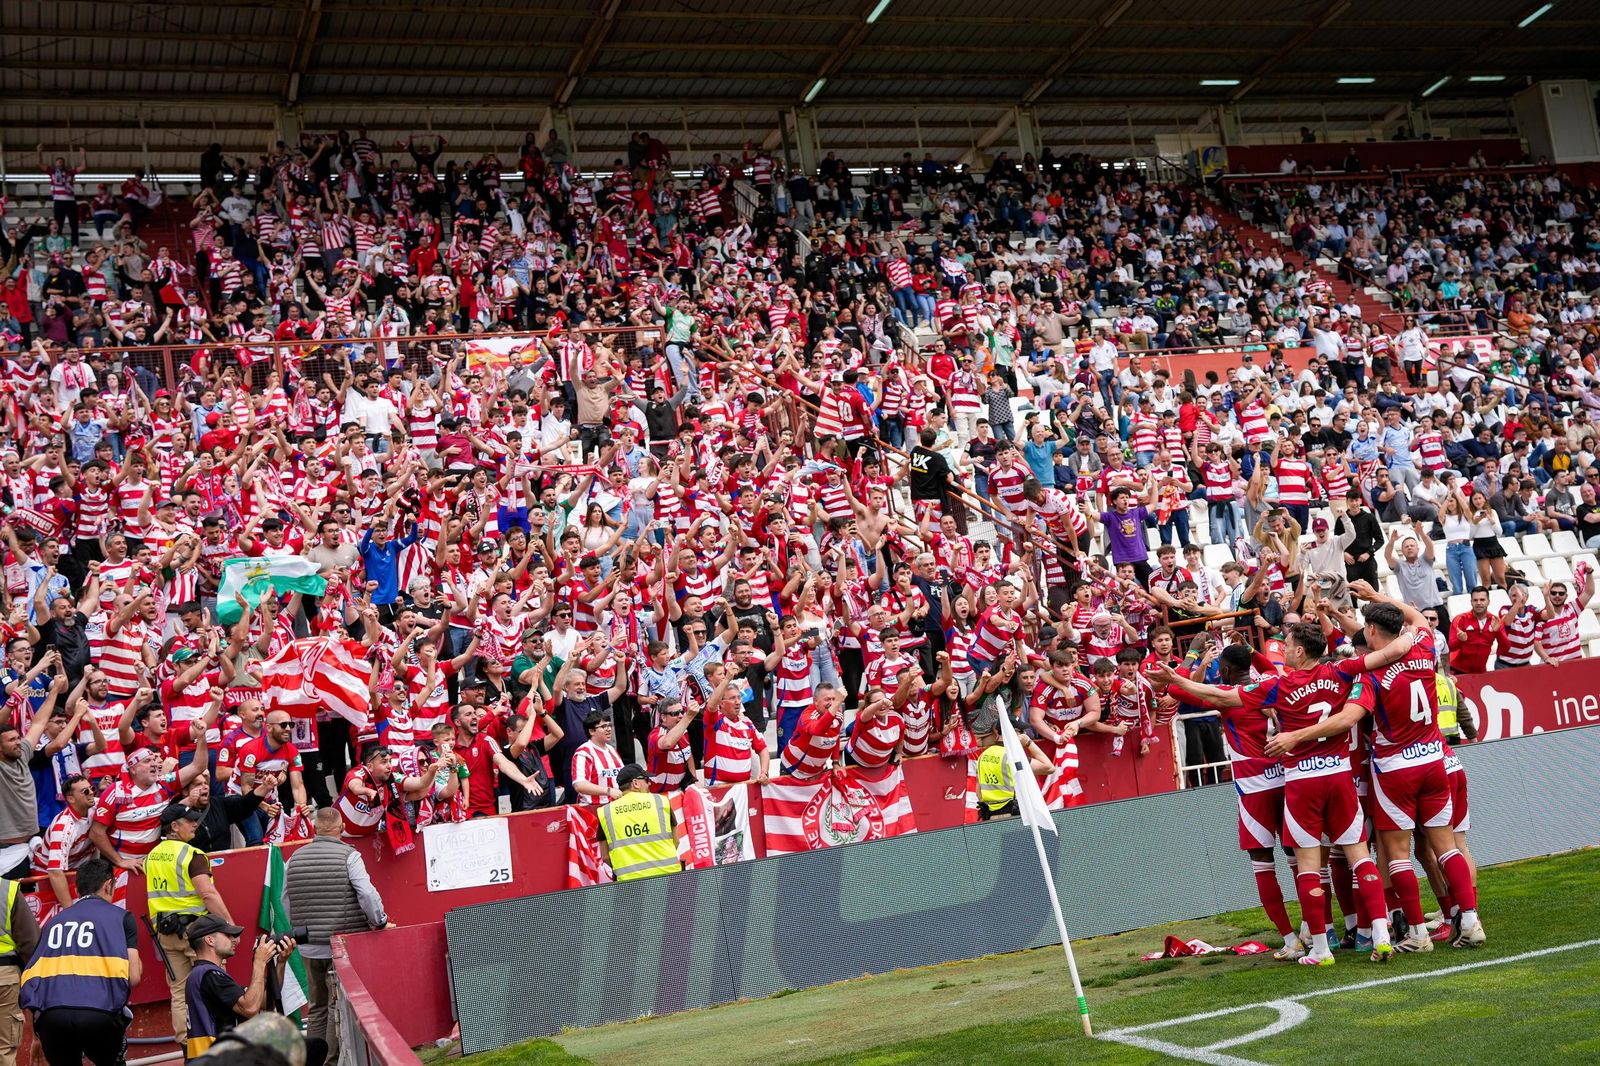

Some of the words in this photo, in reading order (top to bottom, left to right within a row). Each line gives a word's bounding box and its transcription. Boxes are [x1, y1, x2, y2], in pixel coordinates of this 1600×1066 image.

[838, 400, 853, 422] 10
[1381, 662, 1408, 691] MIGUEL
[1285, 682, 1318, 706] LUCAS
[1410, 679, 1432, 726] 4
[1437, 694, 1448, 706] 14
[1552, 690, 1600, 726] ine
[1402, 739, 1440, 760] wiber
[1264, 761, 1285, 780] wib
[1298, 754, 1340, 772] wiber
[614, 801, 652, 815] SEGURIDAD
[624, 821, 650, 838] 064
[489, 867, 510, 884] 25
[47, 920, 95, 950] 076
